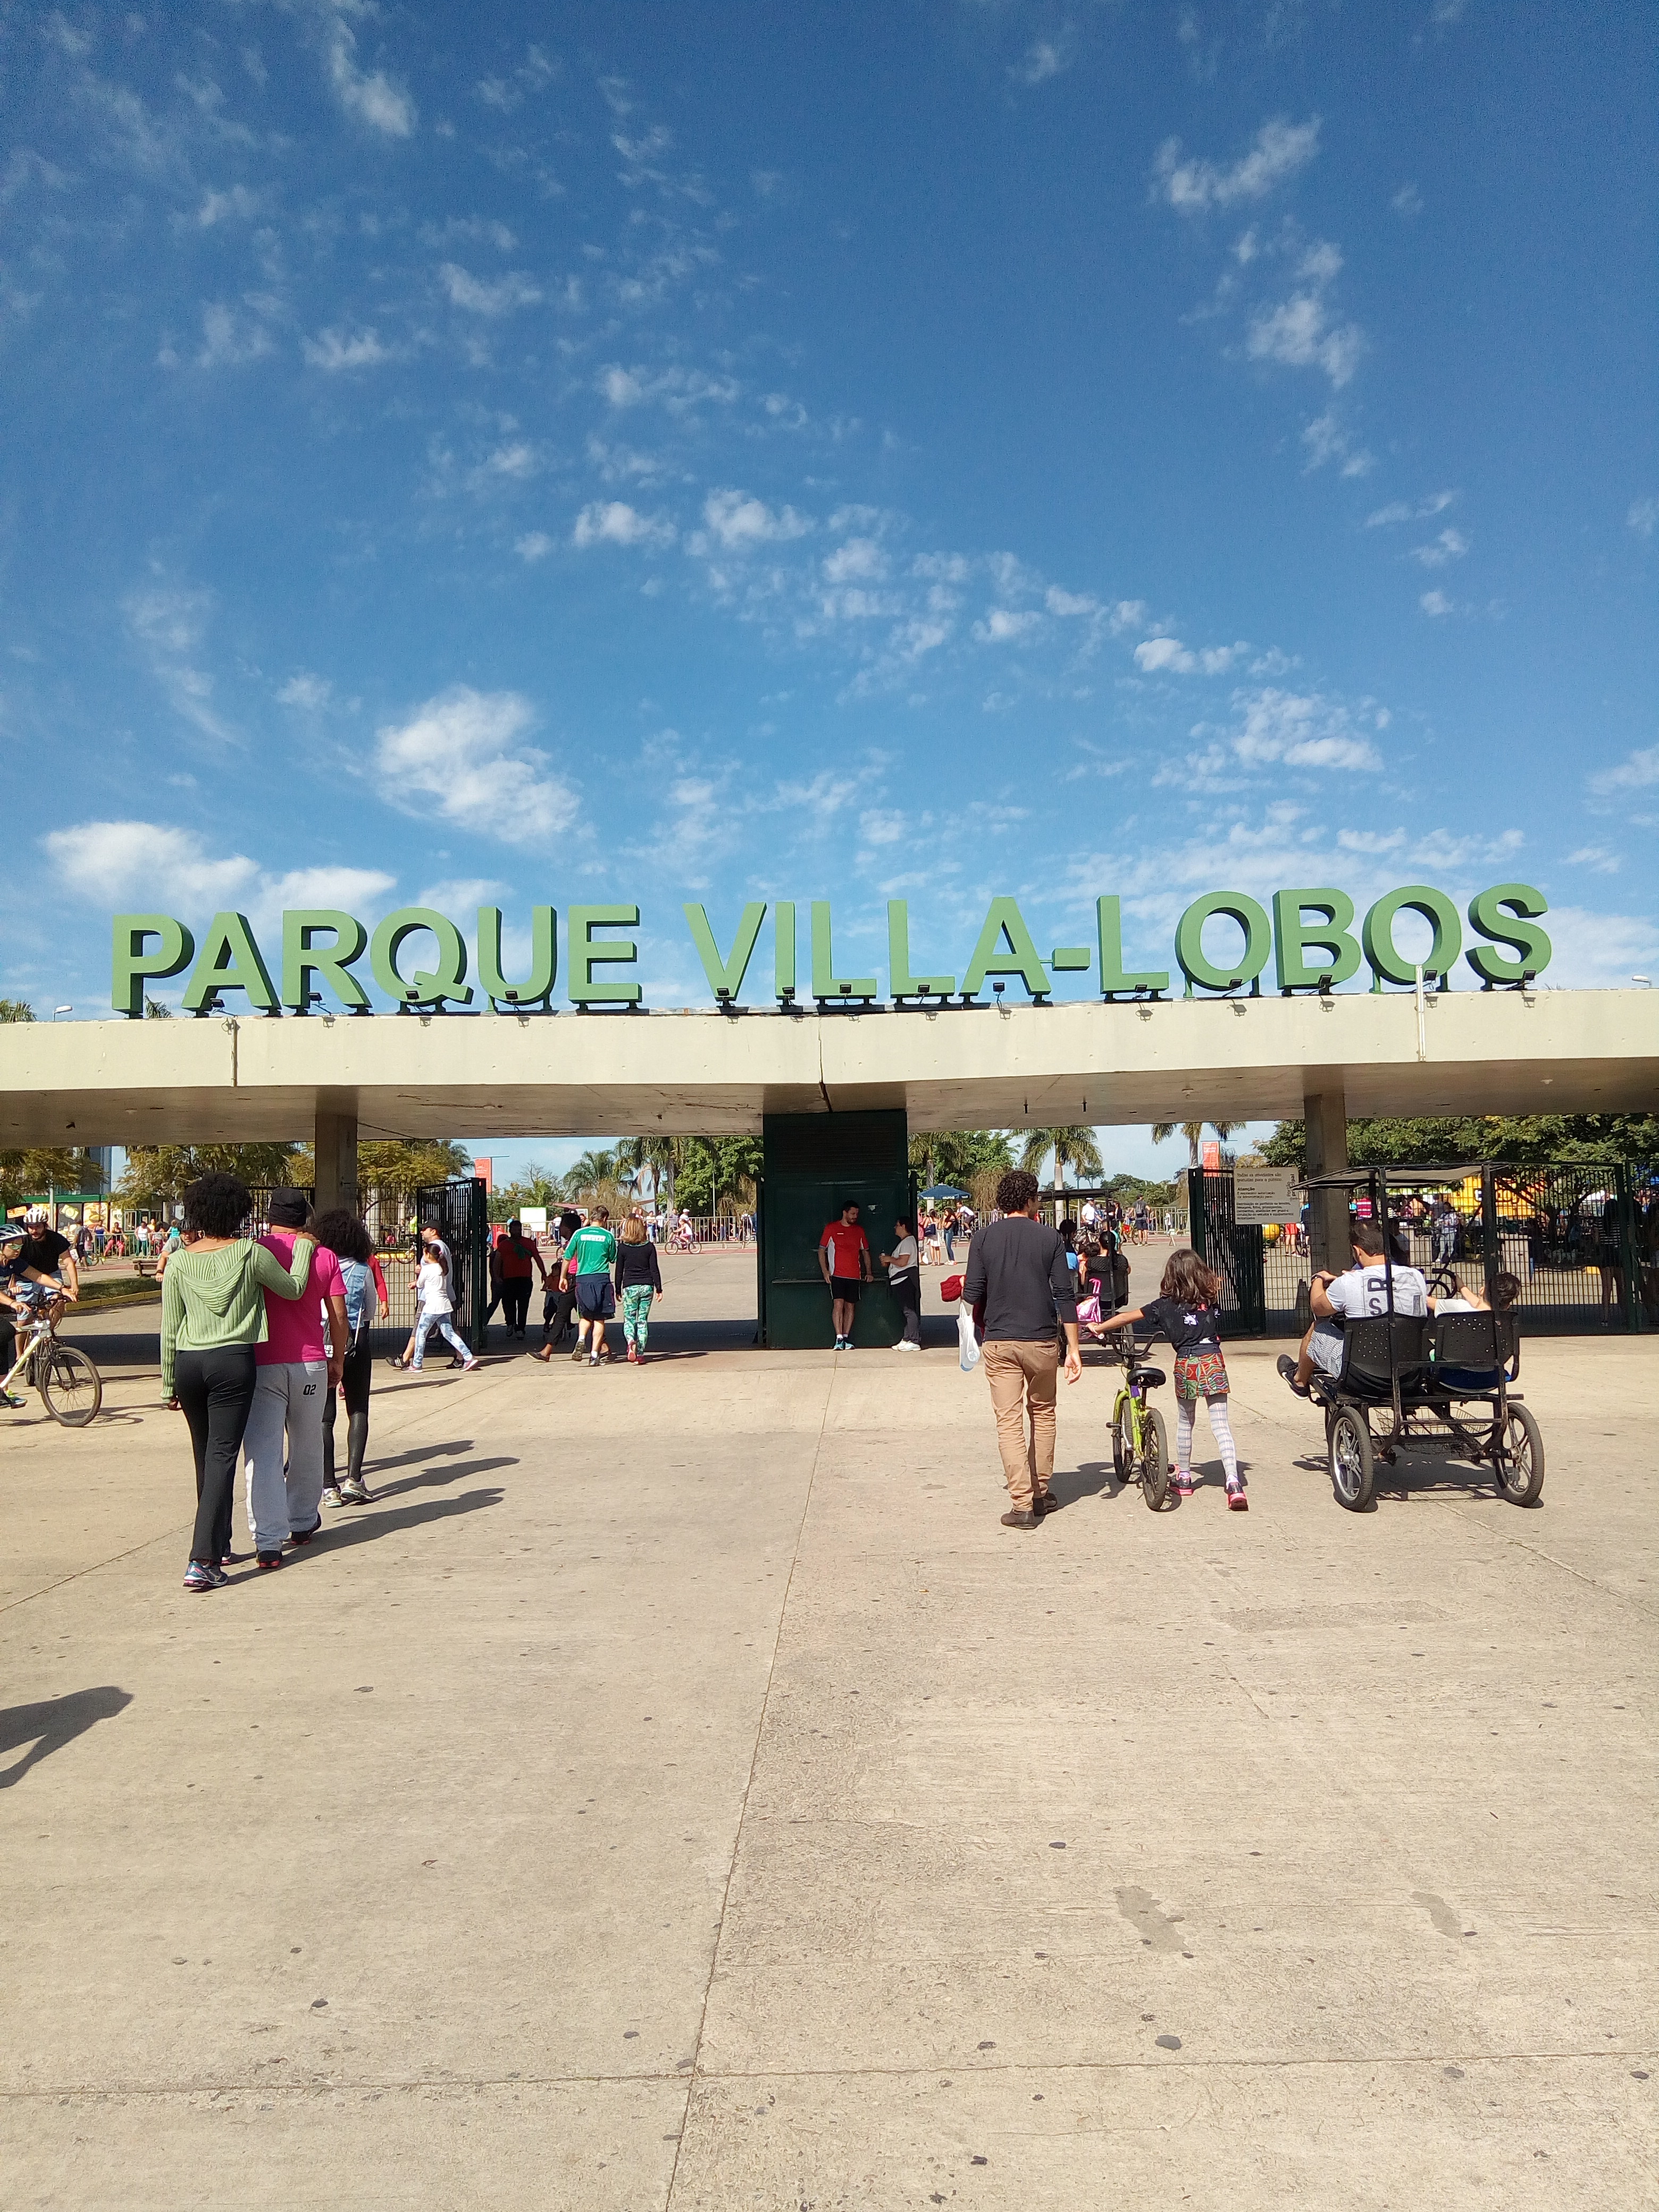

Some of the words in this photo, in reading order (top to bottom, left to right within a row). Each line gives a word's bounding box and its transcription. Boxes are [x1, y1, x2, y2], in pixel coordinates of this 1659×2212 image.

[111, 904, 642, 1014] PARQUE
[682, 883, 1553, 1001] VILLA-LOBOS
[303, 1384, 316, 1395] 02
